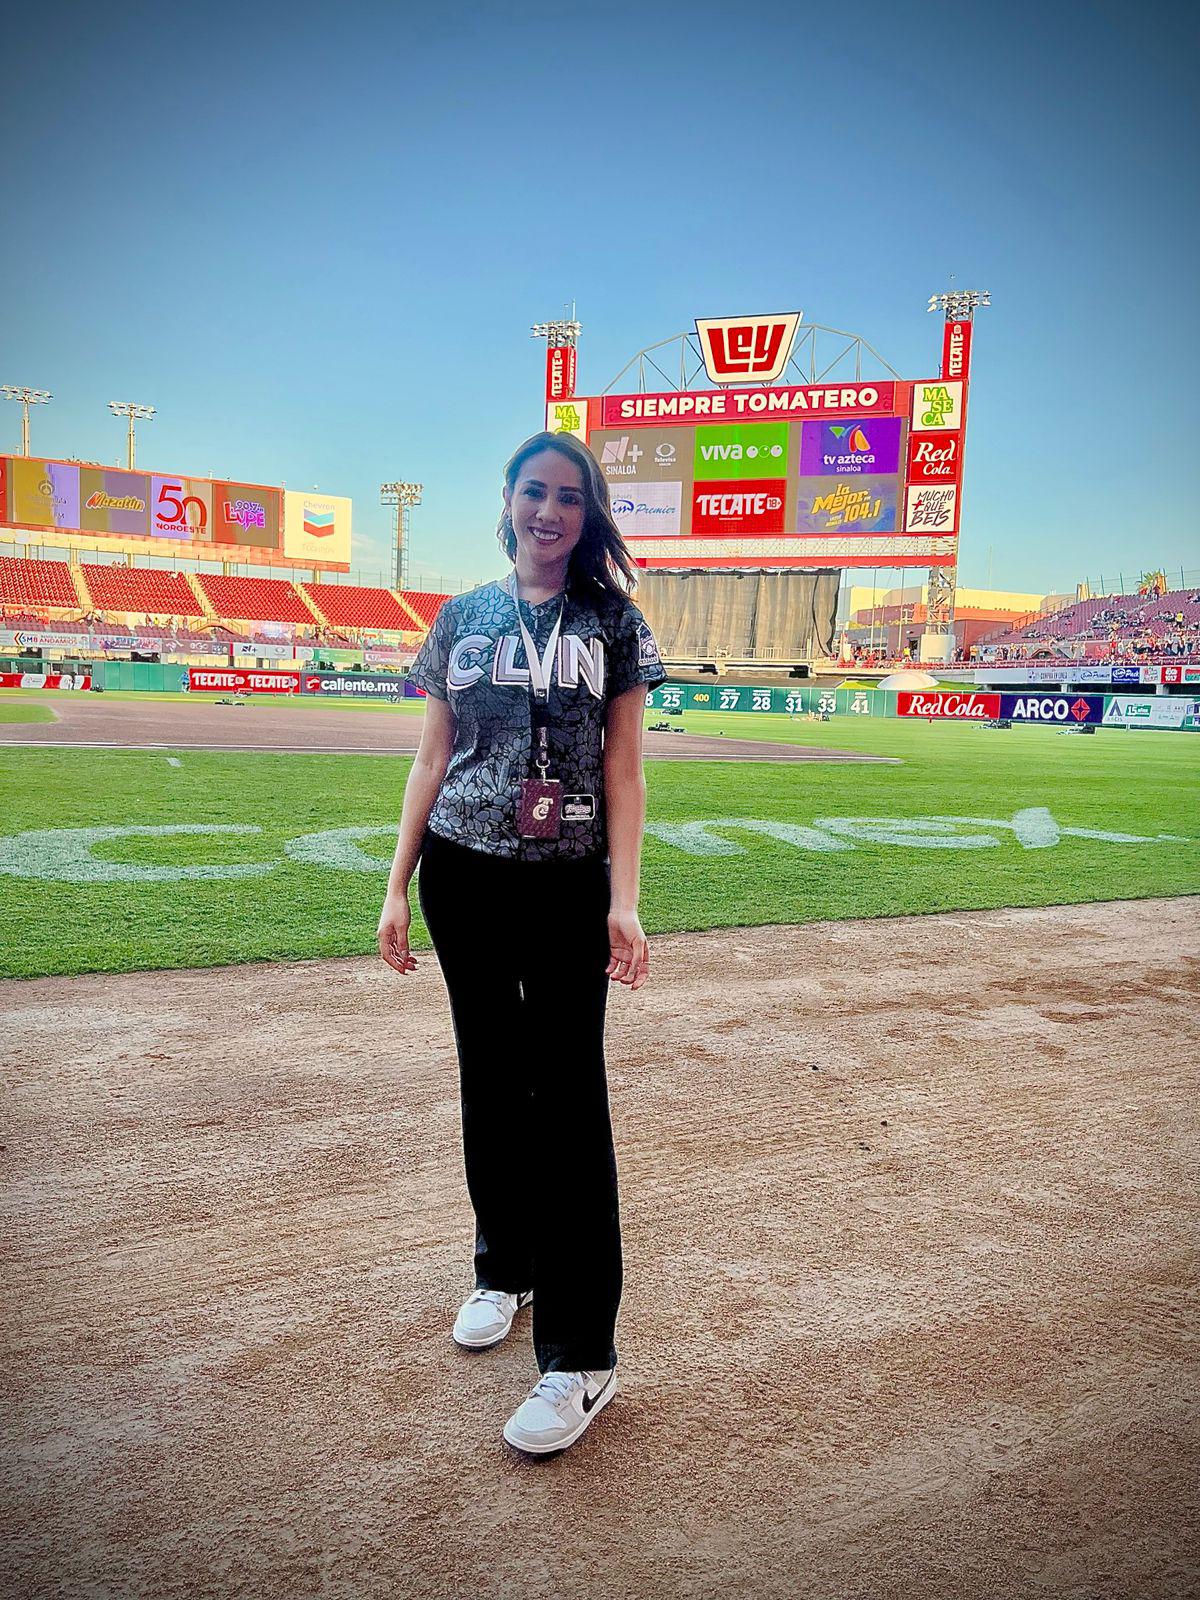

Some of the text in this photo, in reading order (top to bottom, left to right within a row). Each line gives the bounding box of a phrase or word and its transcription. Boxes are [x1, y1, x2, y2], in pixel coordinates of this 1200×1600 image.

[949, 333, 963, 377] TECATE
[620, 387, 879, 418] SIEMPRE TOMATERO
[913, 440, 957, 463] Red
[823, 453, 876, 465] tv azteca
[605, 464, 637, 475] SINALOA
[836, 465, 862, 473] sinaloa
[923, 462, 951, 475] Cola
[811, 490, 869, 514] Mejor
[917, 489, 955, 502] MUCHO
[303, 500, 336, 511] Chevron
[696, 492, 770, 516] TECATE
[844, 499, 881, 523] 104.1
[908, 509, 952, 528] BEIS
[156, 523, 206, 535] NOROESTE
[192, 672, 290, 689] TECATE TECATE
[320, 677, 399, 693] caliente.mx
[662, 694, 681, 707] 25
[693, 693, 710, 702] 400
[720, 695, 739, 709] 27
[752, 697, 771, 711] 28
[785, 698, 803, 712] 31
[818, 699, 836, 713] 33
[850, 699, 870, 714] 41
[907, 694, 986, 717] Red Cola
[1012, 698, 1069, 720] ARCO
